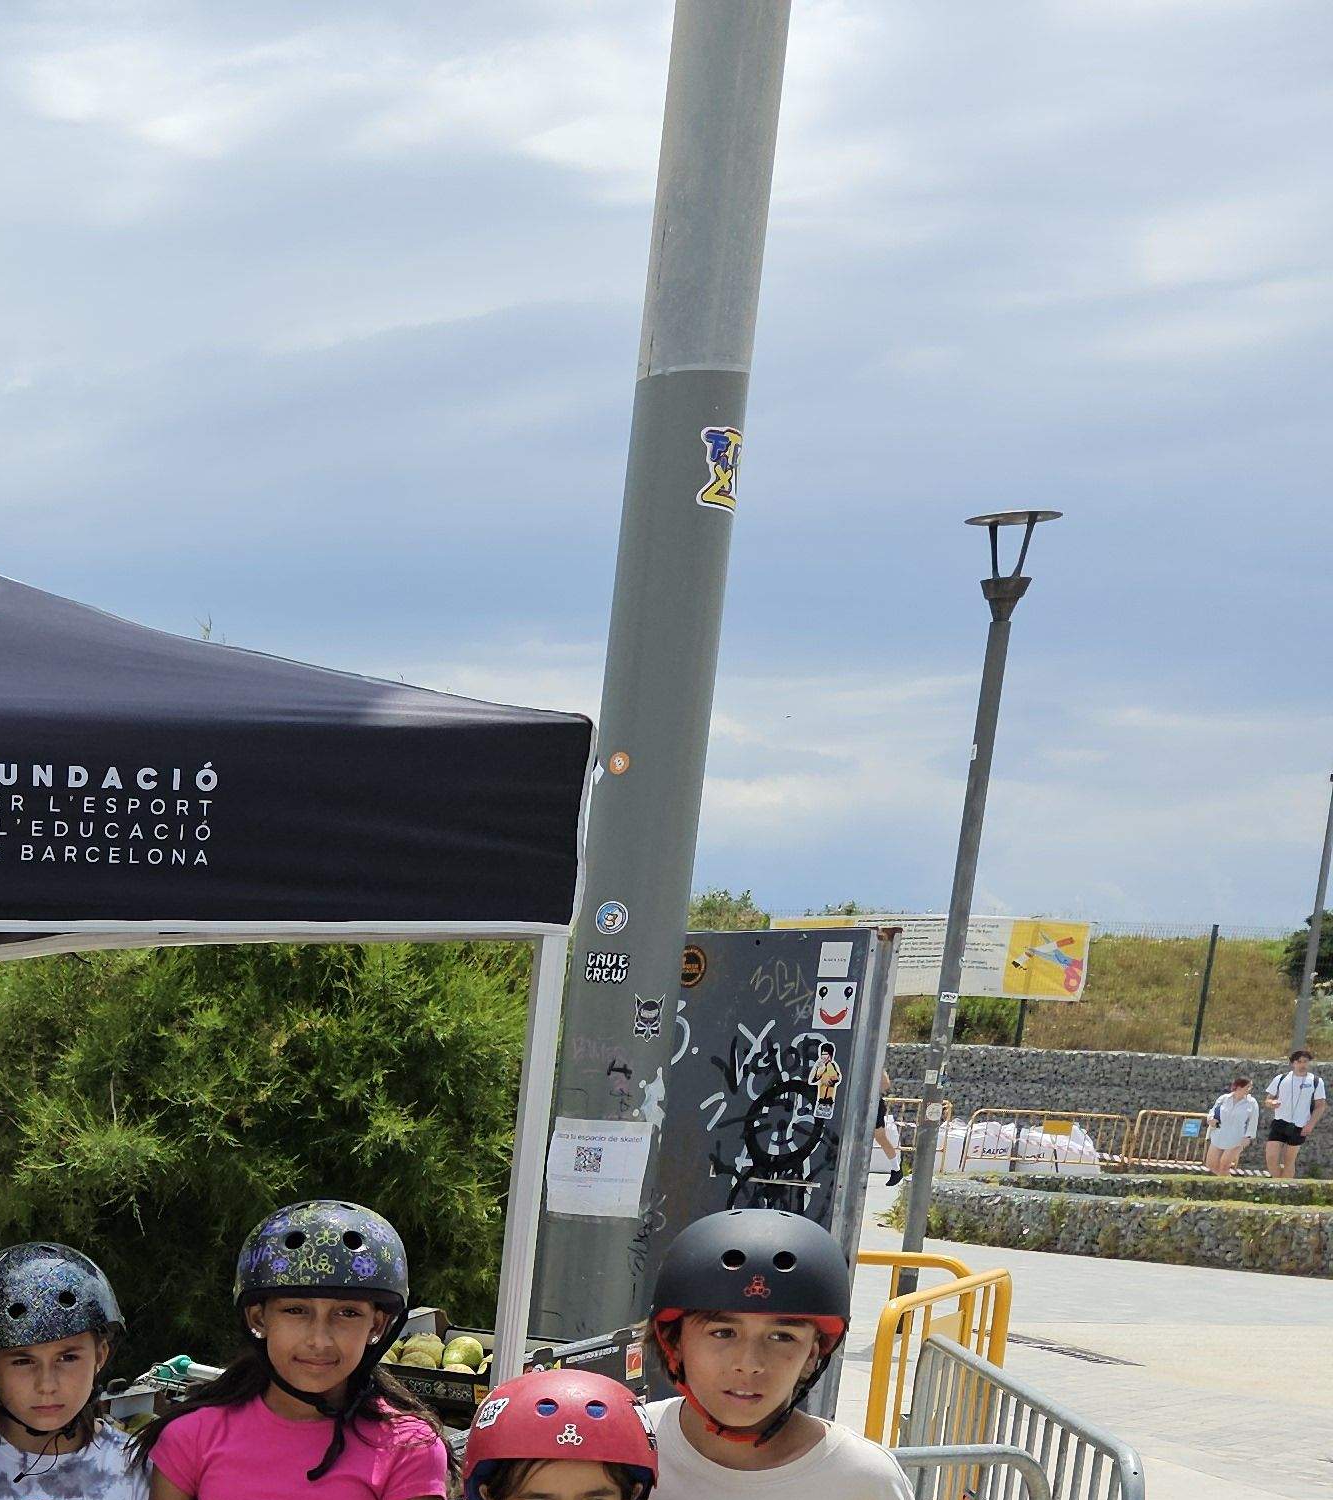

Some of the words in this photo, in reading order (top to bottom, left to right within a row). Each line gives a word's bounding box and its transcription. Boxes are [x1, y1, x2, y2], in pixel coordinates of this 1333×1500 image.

[49, 795, 213, 817] L'ESPORT
[20, 844, 209, 866] BARCELONA
[587, 952, 630, 969] CAVE
[585, 966, 629, 984] CREW
